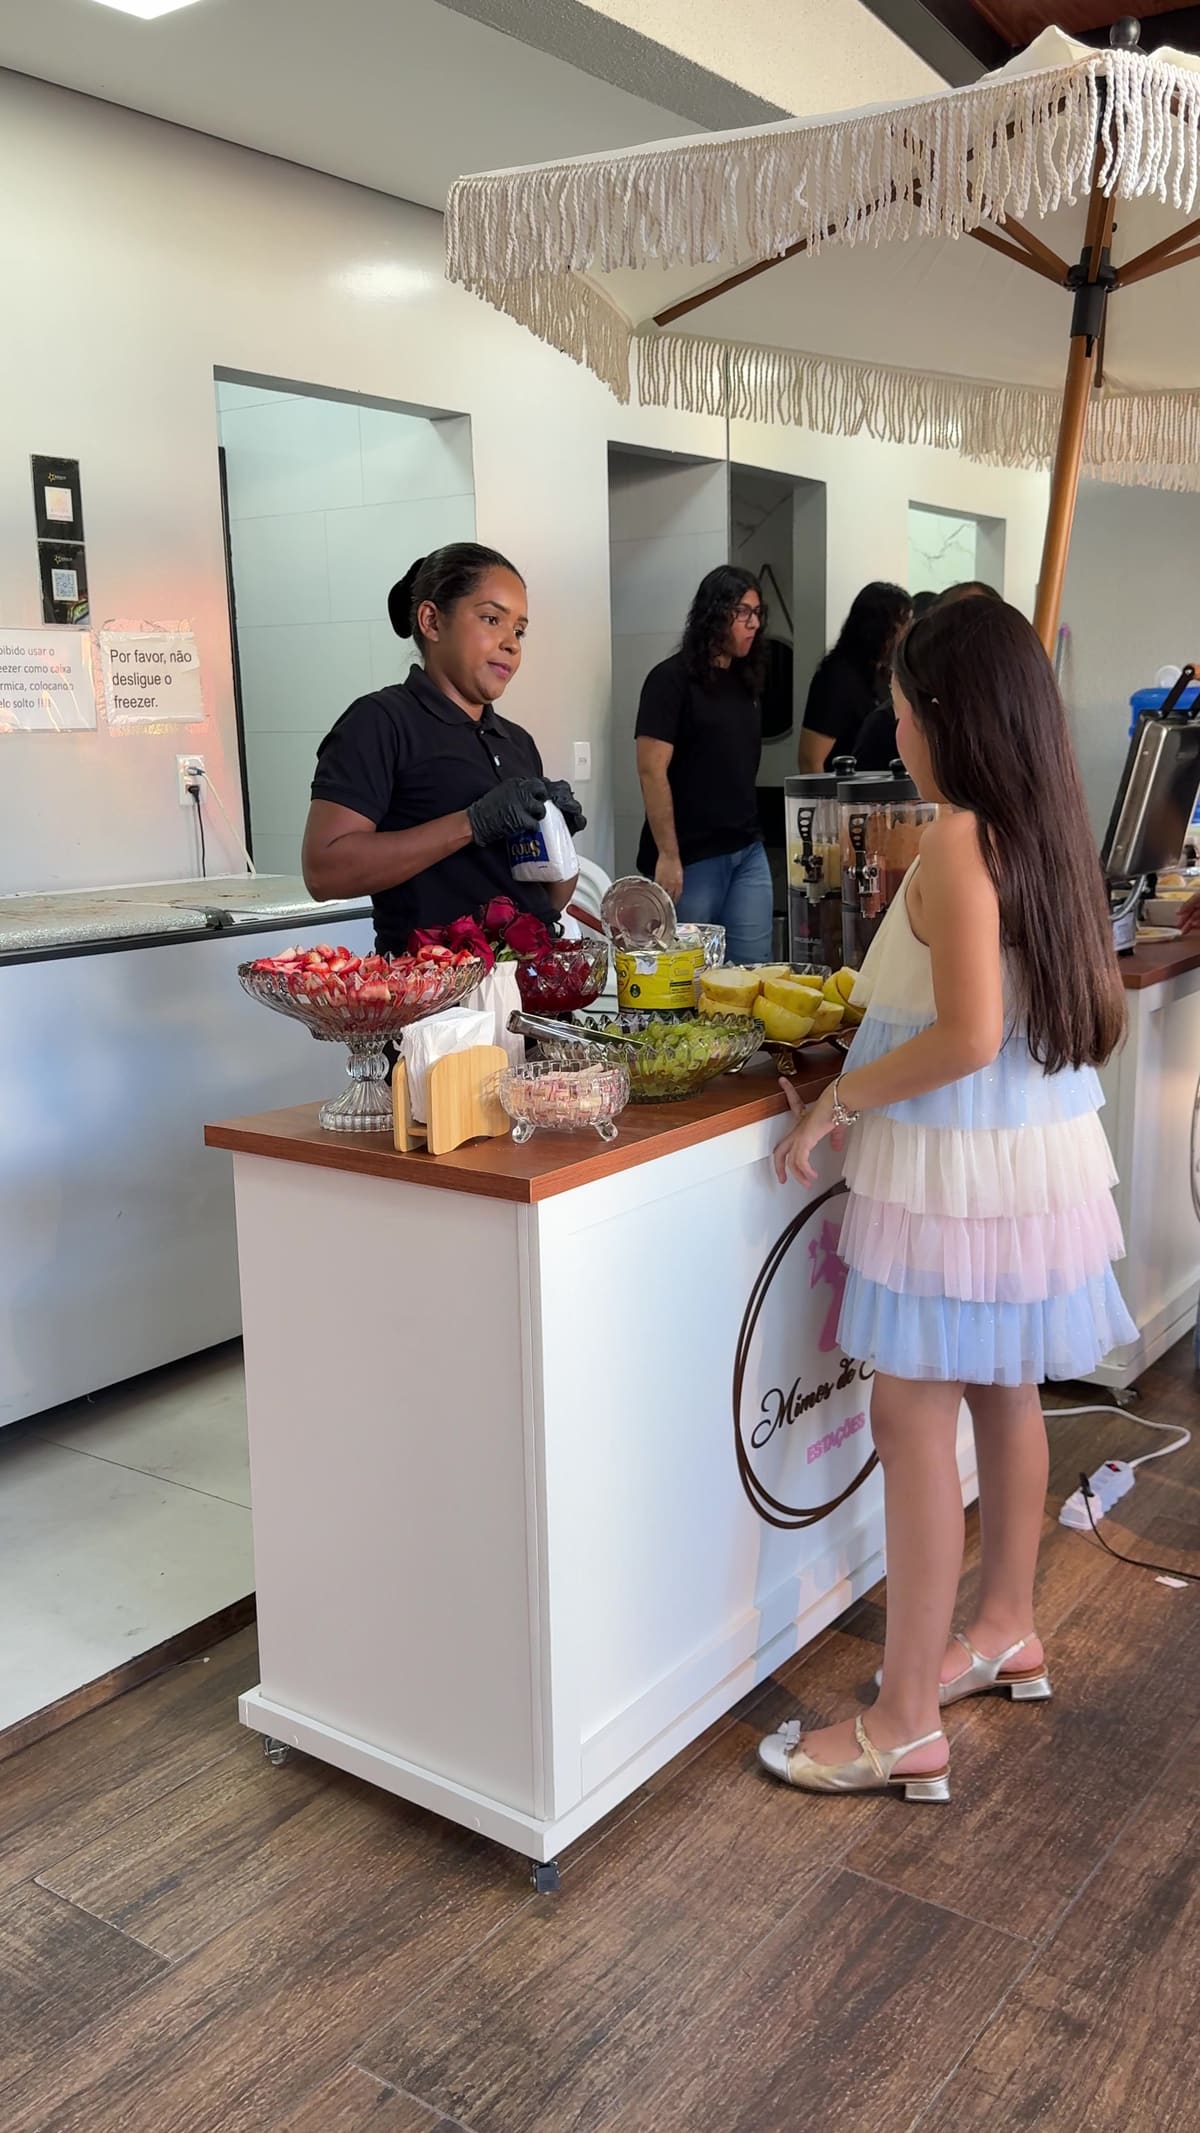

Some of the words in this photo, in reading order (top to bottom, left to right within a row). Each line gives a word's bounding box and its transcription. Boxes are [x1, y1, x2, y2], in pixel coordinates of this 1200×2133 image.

[27, 647, 46, 656] usar
[48, 648, 55, 656] o
[110, 648, 131, 663] Por
[134, 649, 167, 664] favor,
[169, 650, 192, 663] não
[23, 665, 48, 674] como
[50, 664, 72, 674] caixa
[112, 672, 161, 689] desligue
[164, 674, 173, 685] o
[13, 698, 35, 708] solto
[114, 695, 158, 708] freezer.
[751, 1377, 834, 1449] Mimos
[806, 1411, 866, 1465] ESTAÇÕES
